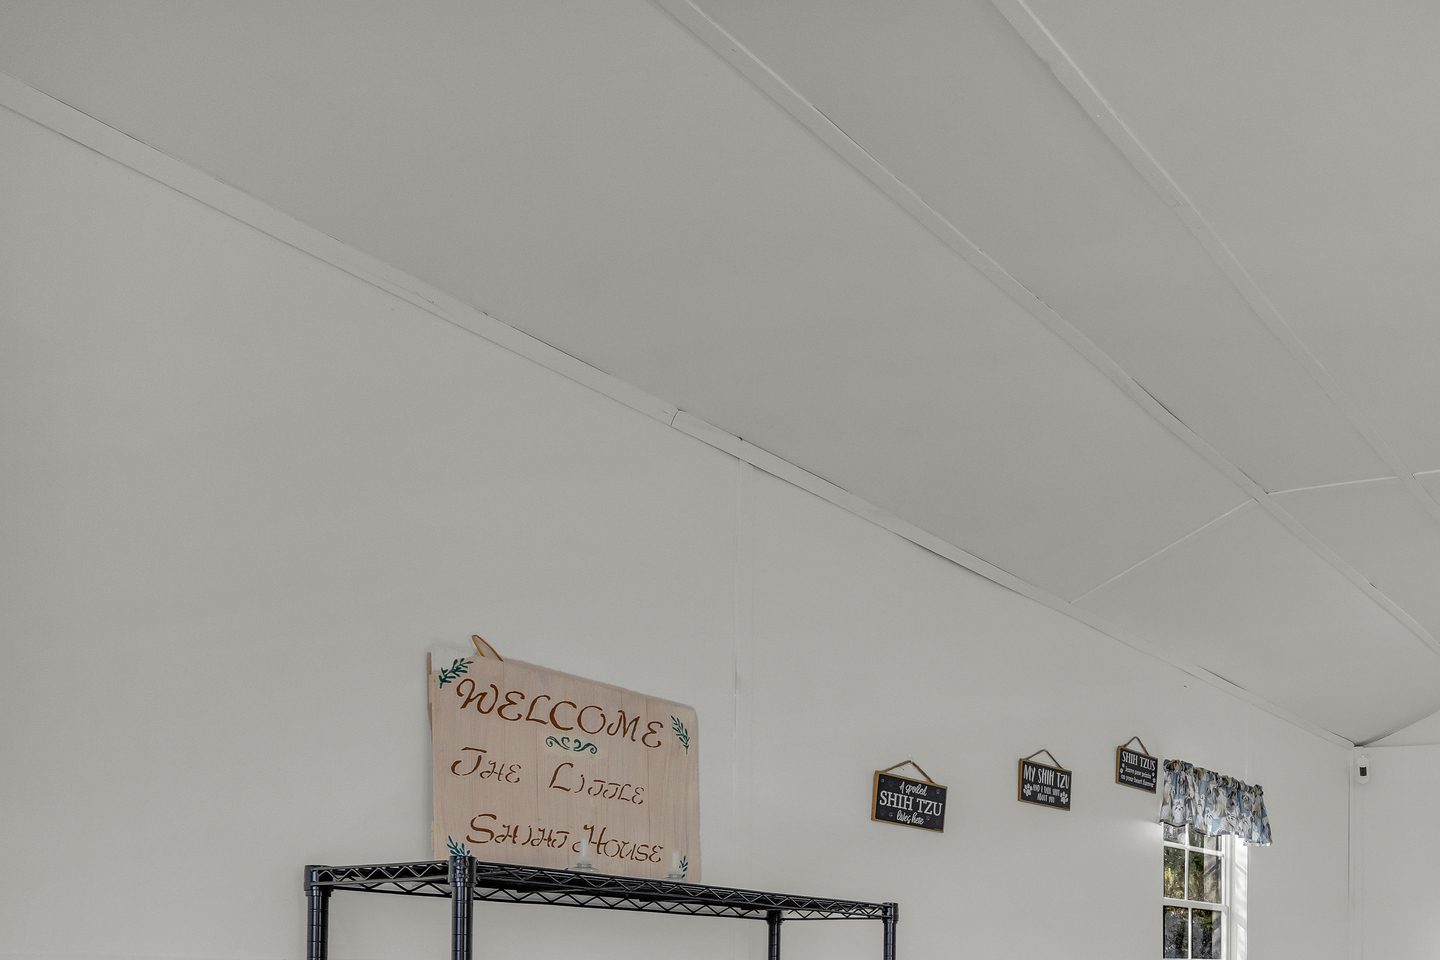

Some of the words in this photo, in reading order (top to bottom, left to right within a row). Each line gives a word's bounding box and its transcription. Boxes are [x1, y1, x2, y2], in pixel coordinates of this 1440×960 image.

[456, 678, 664, 748] WELCOME
[450, 746, 522, 783] THE
[1122, 751, 1138, 766] SHIH
[549, 762, 644, 805] LITTLE
[899, 781, 905, 794] A
[1023, 764, 1036, 782] MY
[1037, 768, 1055, 786] SHIH
[1056, 772, 1070, 789] TZU
[879, 790, 914, 811] SHIH
[916, 798, 943, 817] TZU
[896, 810, 911, 824] lives
[911, 812, 925, 825] here
[572, 824, 664, 863] HOUSE
